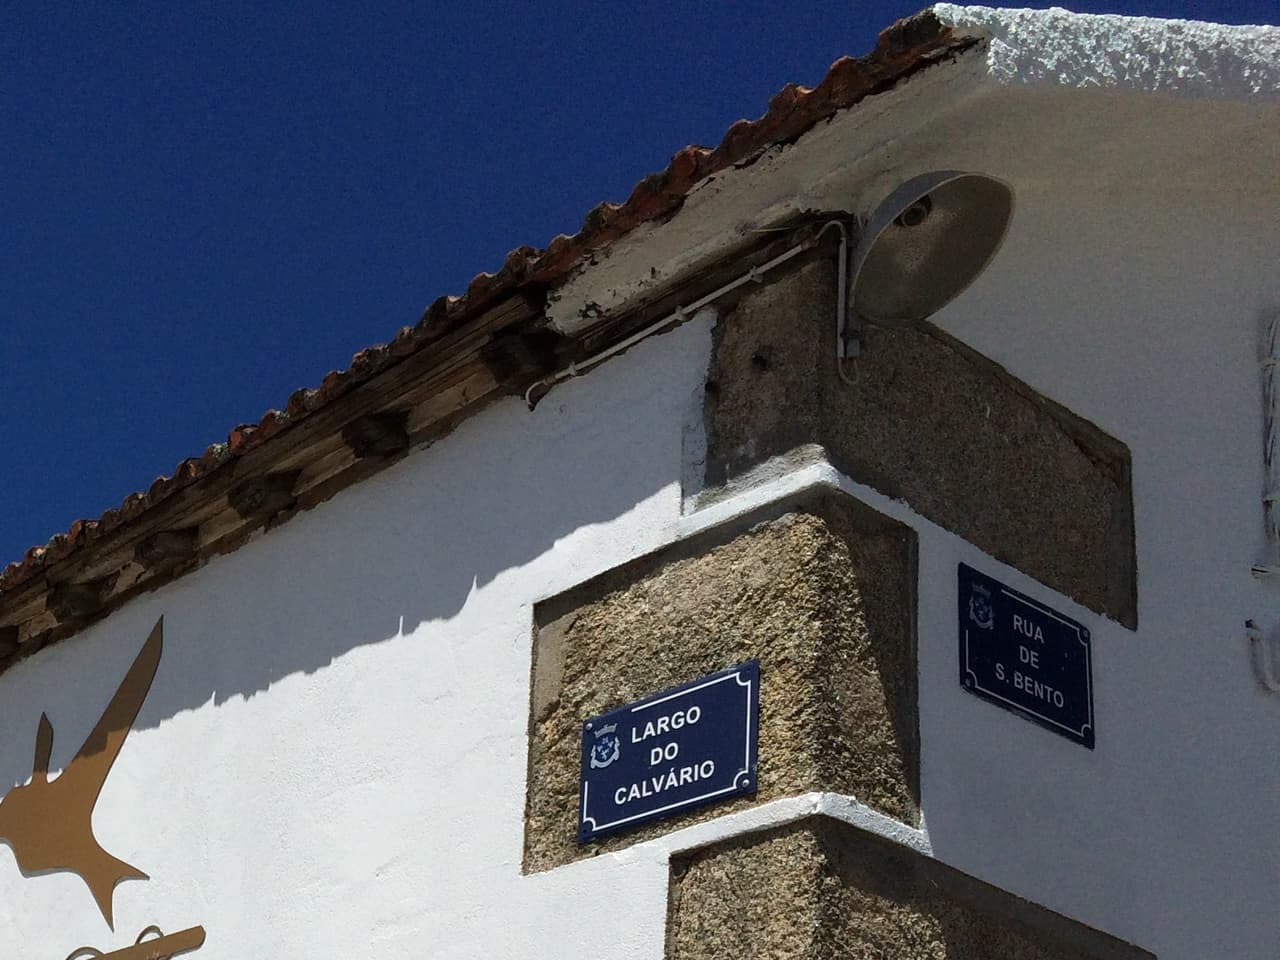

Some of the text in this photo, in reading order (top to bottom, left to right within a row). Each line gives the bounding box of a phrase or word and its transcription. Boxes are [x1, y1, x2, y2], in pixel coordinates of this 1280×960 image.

[1013, 614, 1045, 644] RUA
[1019, 645, 1040, 669] DE
[995, 663, 1064, 708] S. BENTO
[631, 705, 701, 744] LARGO
[650, 742, 678, 766] DO
[614, 759, 715, 805] CALVÁRIO
